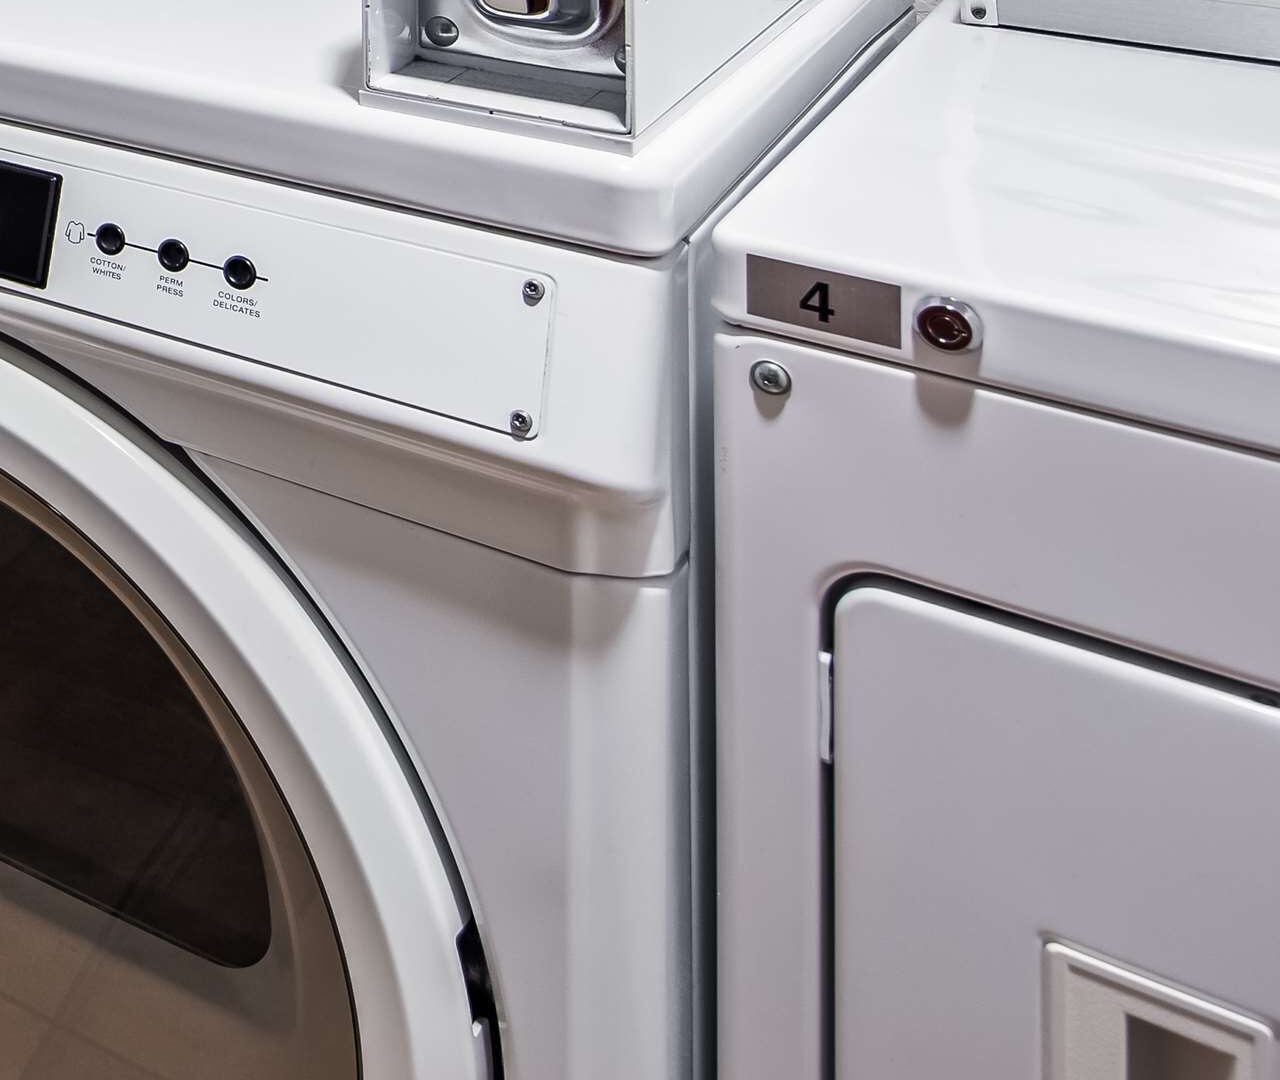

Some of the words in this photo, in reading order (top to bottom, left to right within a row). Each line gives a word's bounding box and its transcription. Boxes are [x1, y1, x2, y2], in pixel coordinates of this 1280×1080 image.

[90, 256, 127, 272] COTTON/
[92, 266, 122, 281] WHITES
[159, 275, 184, 288] PERM
[156, 284, 184, 298] PRESS
[217, 290, 258, 307] COLORS/
[212, 299, 261, 319] DELICATES
[799, 281, 835, 323] 4
